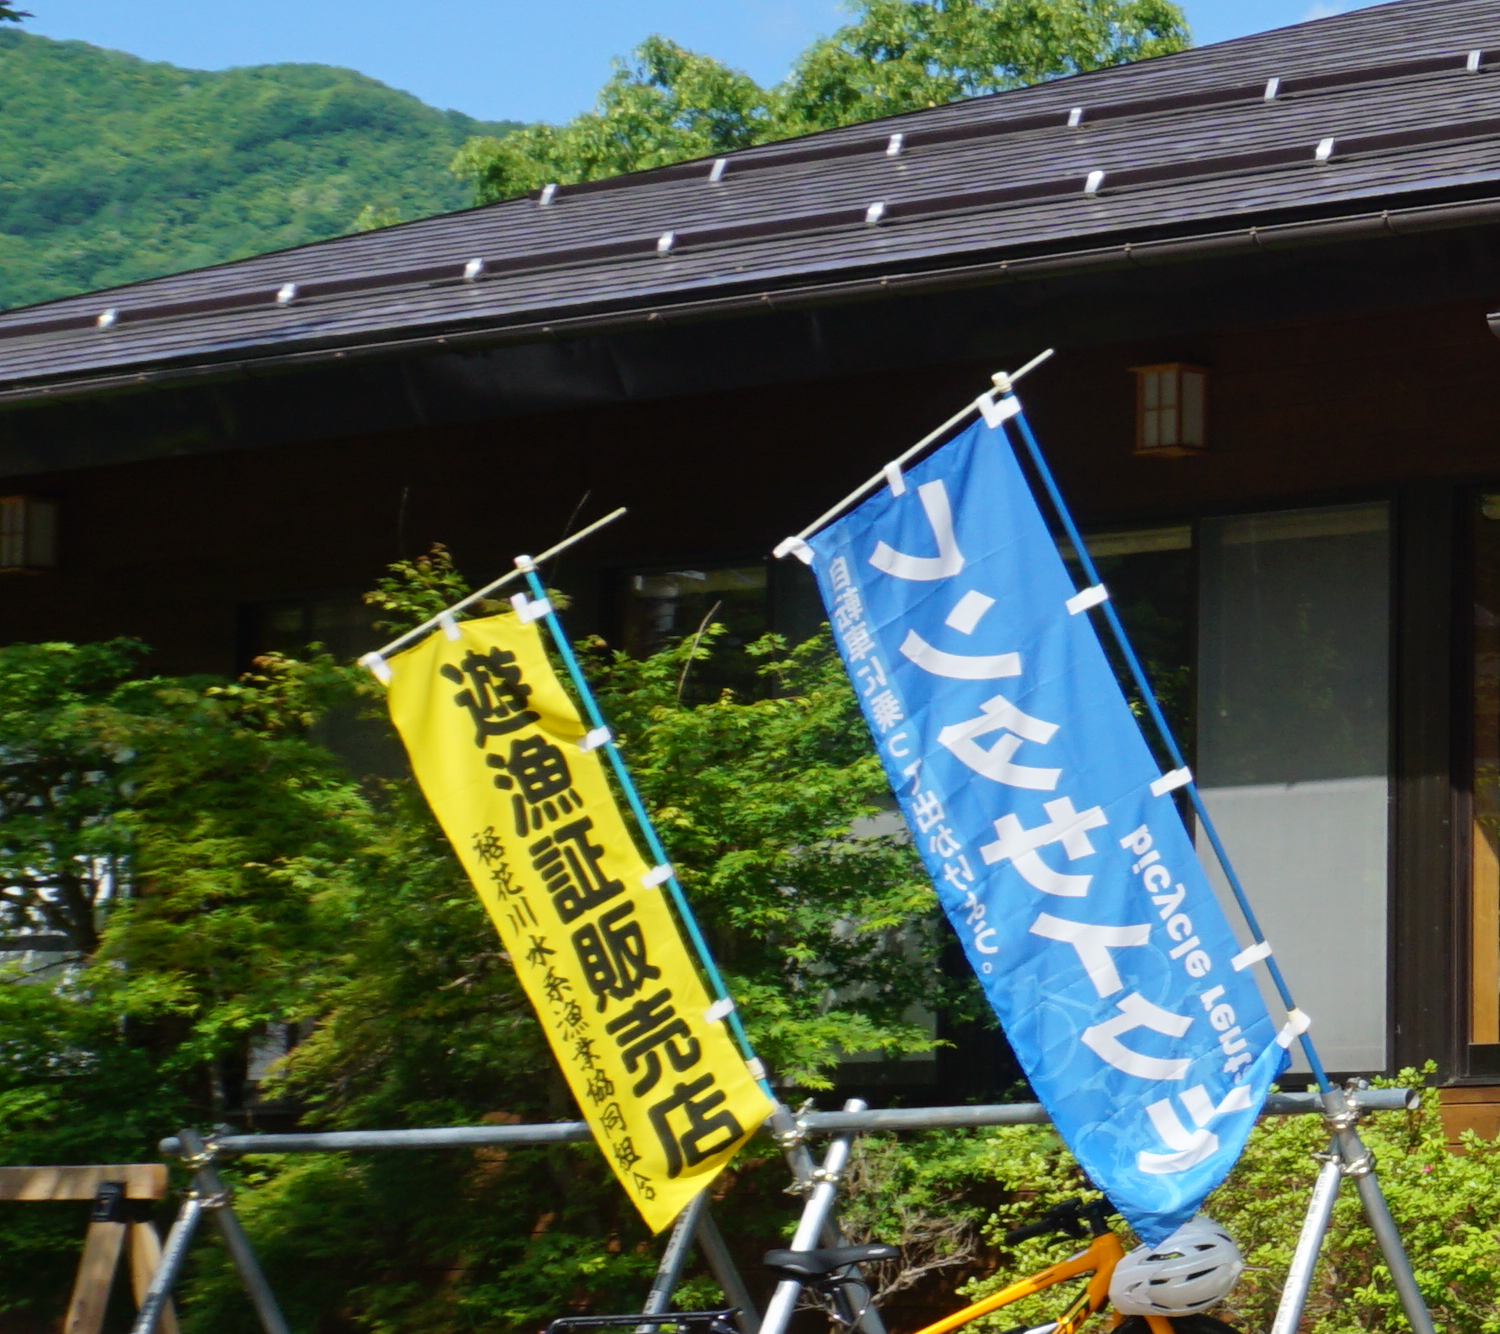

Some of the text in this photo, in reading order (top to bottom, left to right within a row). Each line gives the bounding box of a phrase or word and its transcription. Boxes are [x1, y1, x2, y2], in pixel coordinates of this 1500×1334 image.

[439, 646, 746, 1180] 遊漁証販売店
